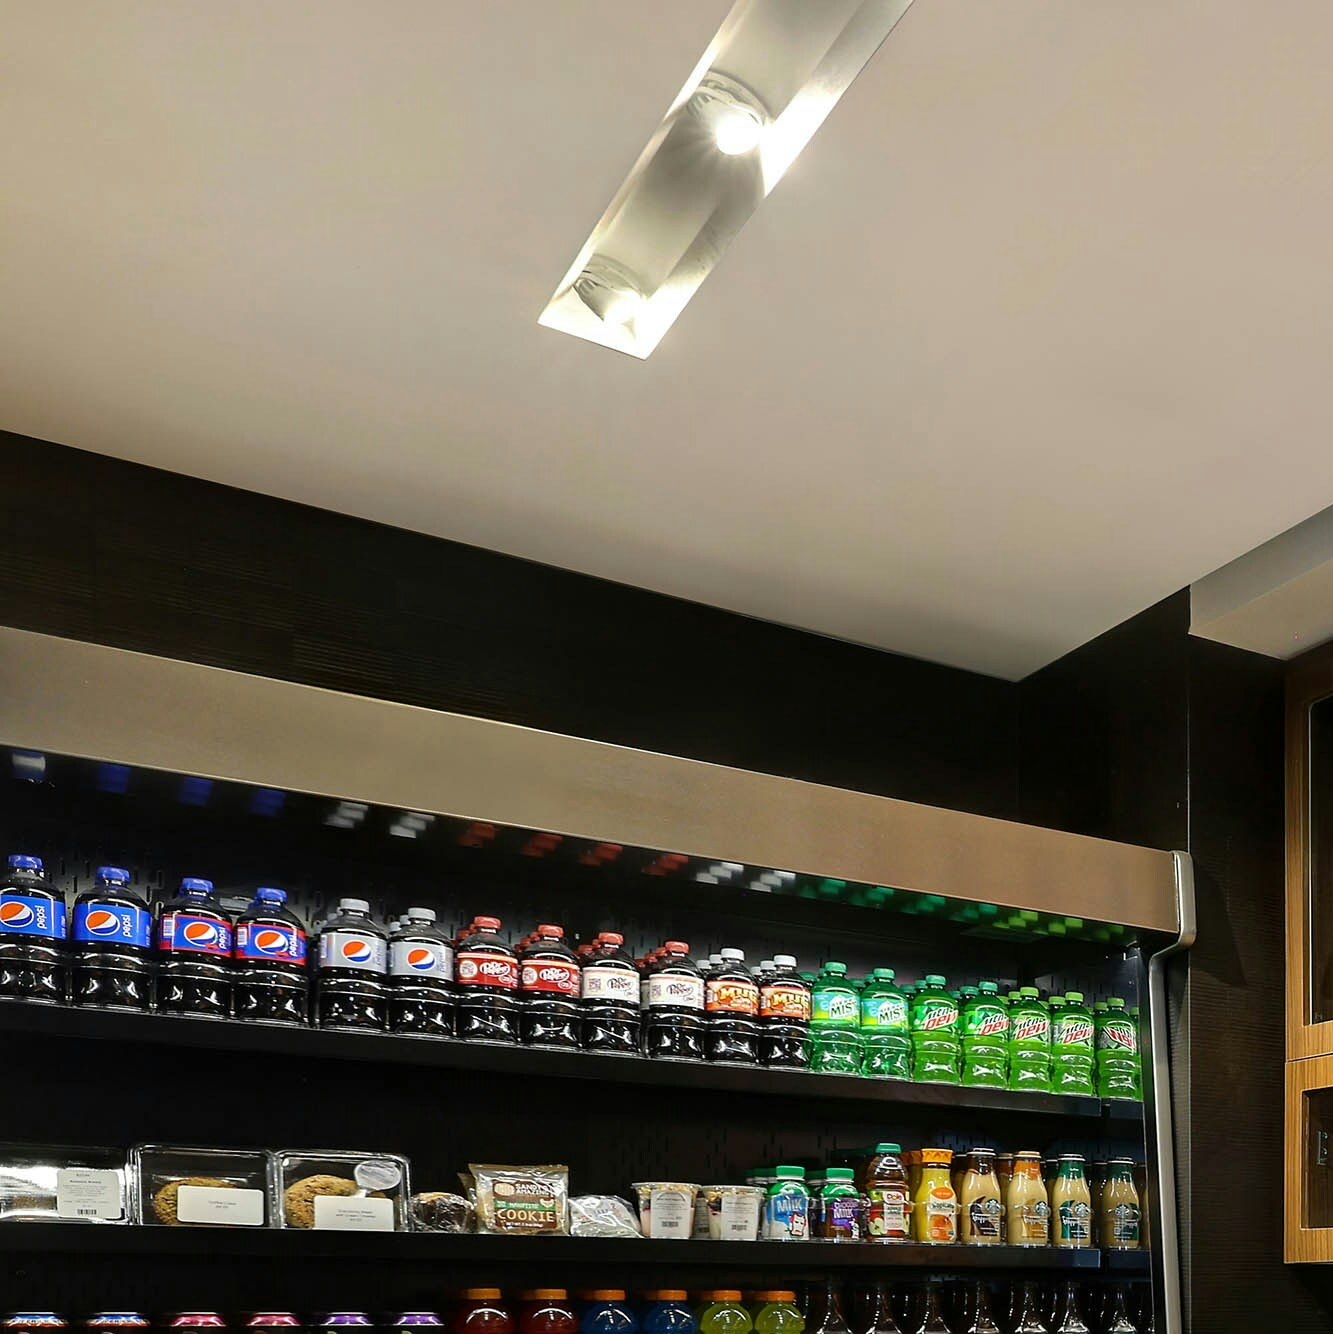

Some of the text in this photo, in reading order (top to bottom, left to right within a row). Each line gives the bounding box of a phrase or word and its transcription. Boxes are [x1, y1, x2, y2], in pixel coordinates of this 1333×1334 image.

[36, 904, 46, 929] pepsi
[121, 914, 132, 938] pepsi
[497, 1209, 554, 1222] COOKIE
